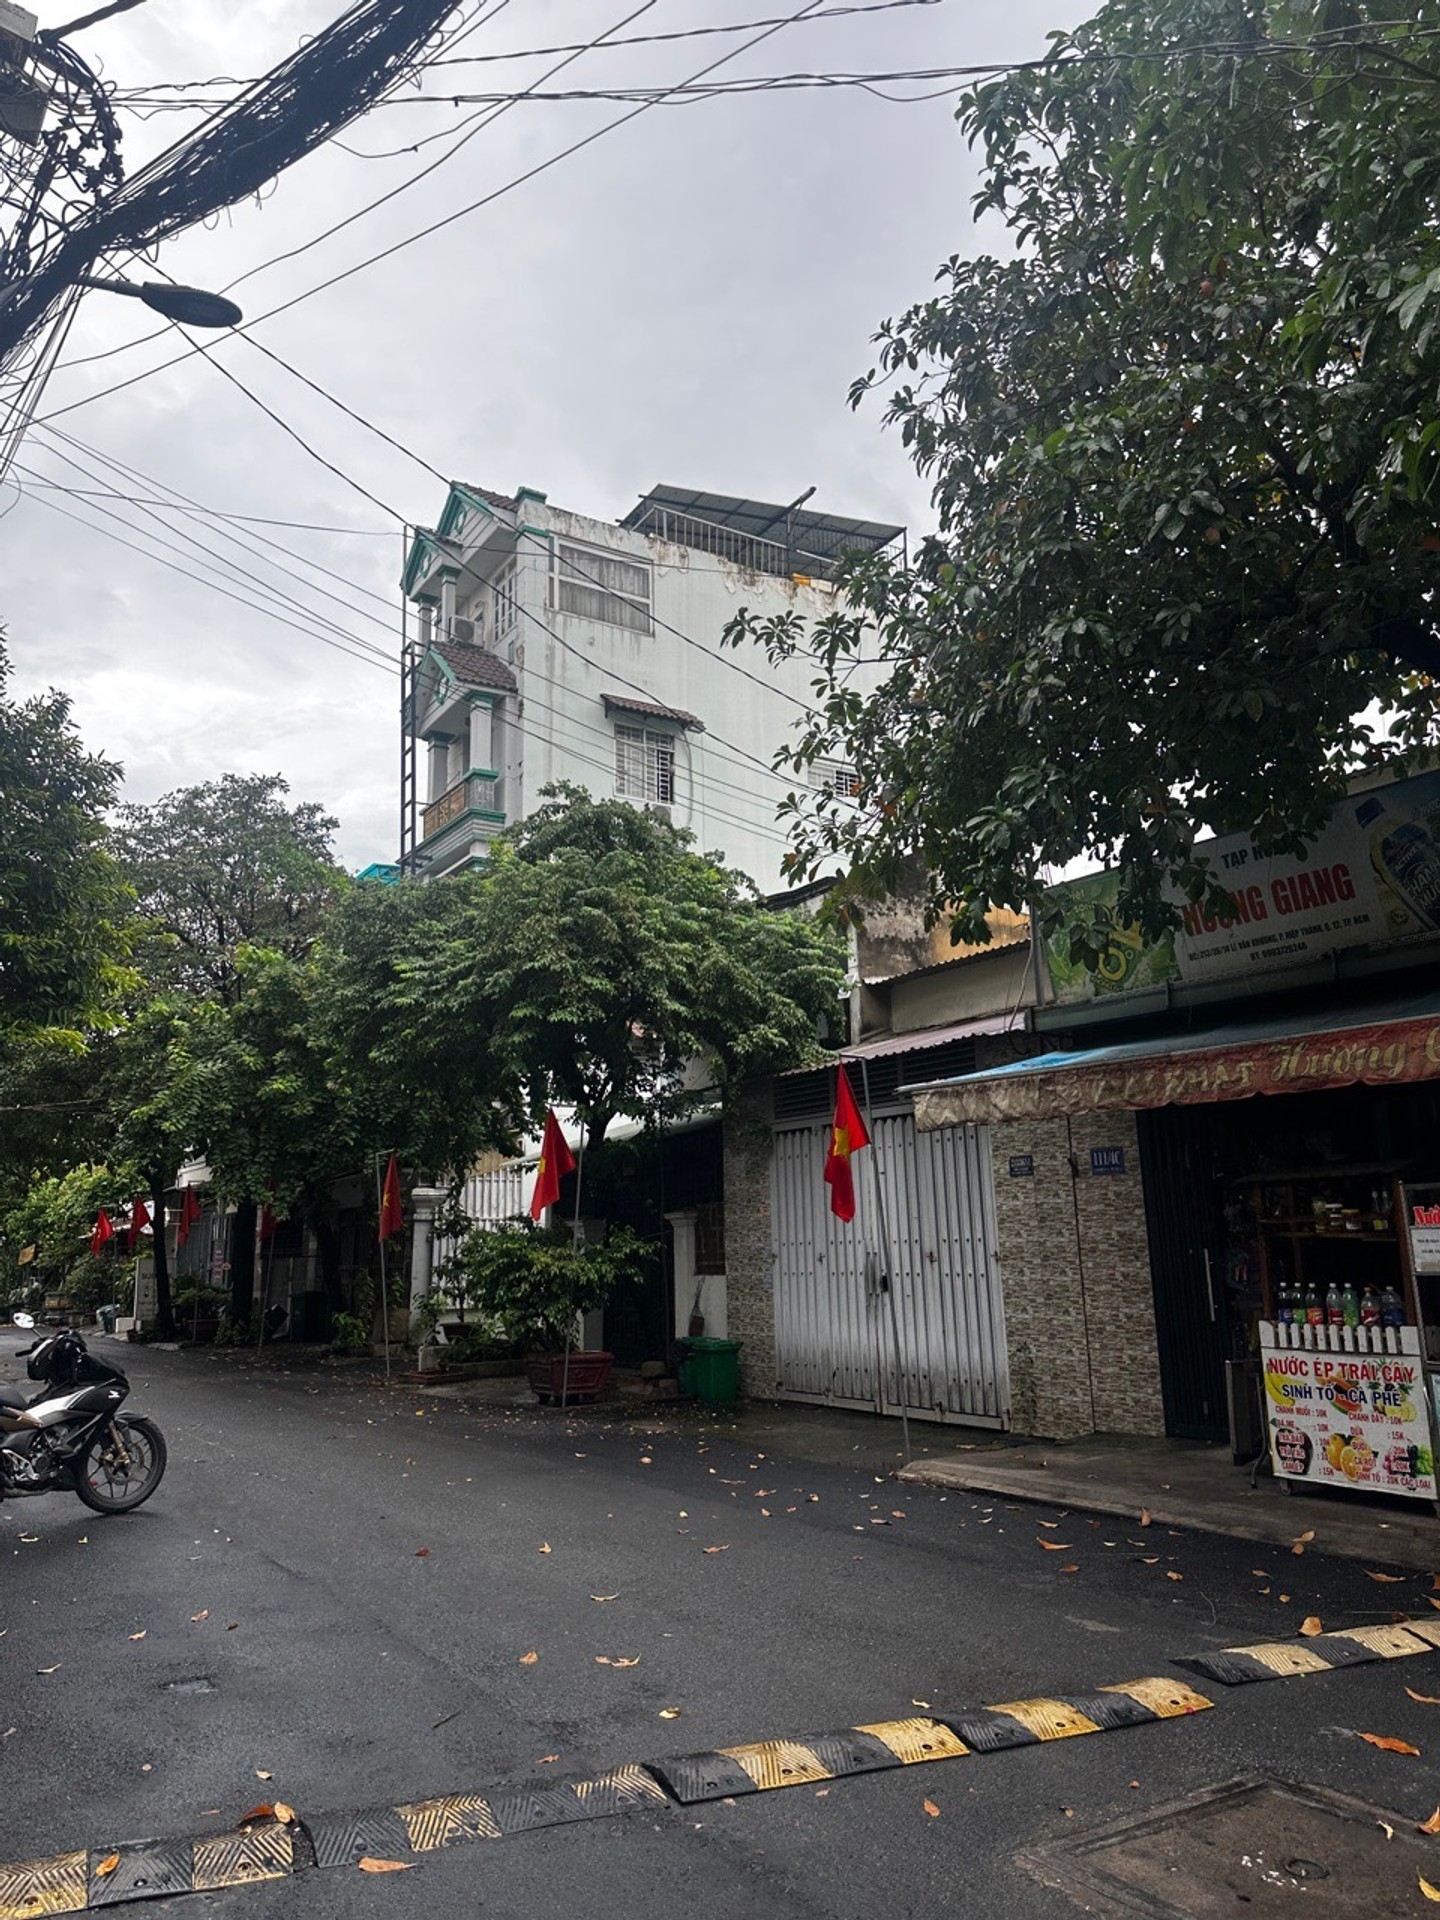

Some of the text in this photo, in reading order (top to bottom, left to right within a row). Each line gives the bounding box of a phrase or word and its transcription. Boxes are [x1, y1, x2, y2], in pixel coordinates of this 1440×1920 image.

[1221, 849, 1248, 869] TẠP
[1271, 864, 1356, 916] GIANG
[1266, 1042, 1406, 1082] Hương
[1269, 1356, 1309, 1377] NƯỚC
[1314, 1357, 1334, 1377] ÉP
[1338, 1360, 1377, 1382] TRÁI
[1382, 1362, 1414, 1384] CÂY
[1282, 1383, 1402, 1407] SINH TỐ CÀ PHÊ
